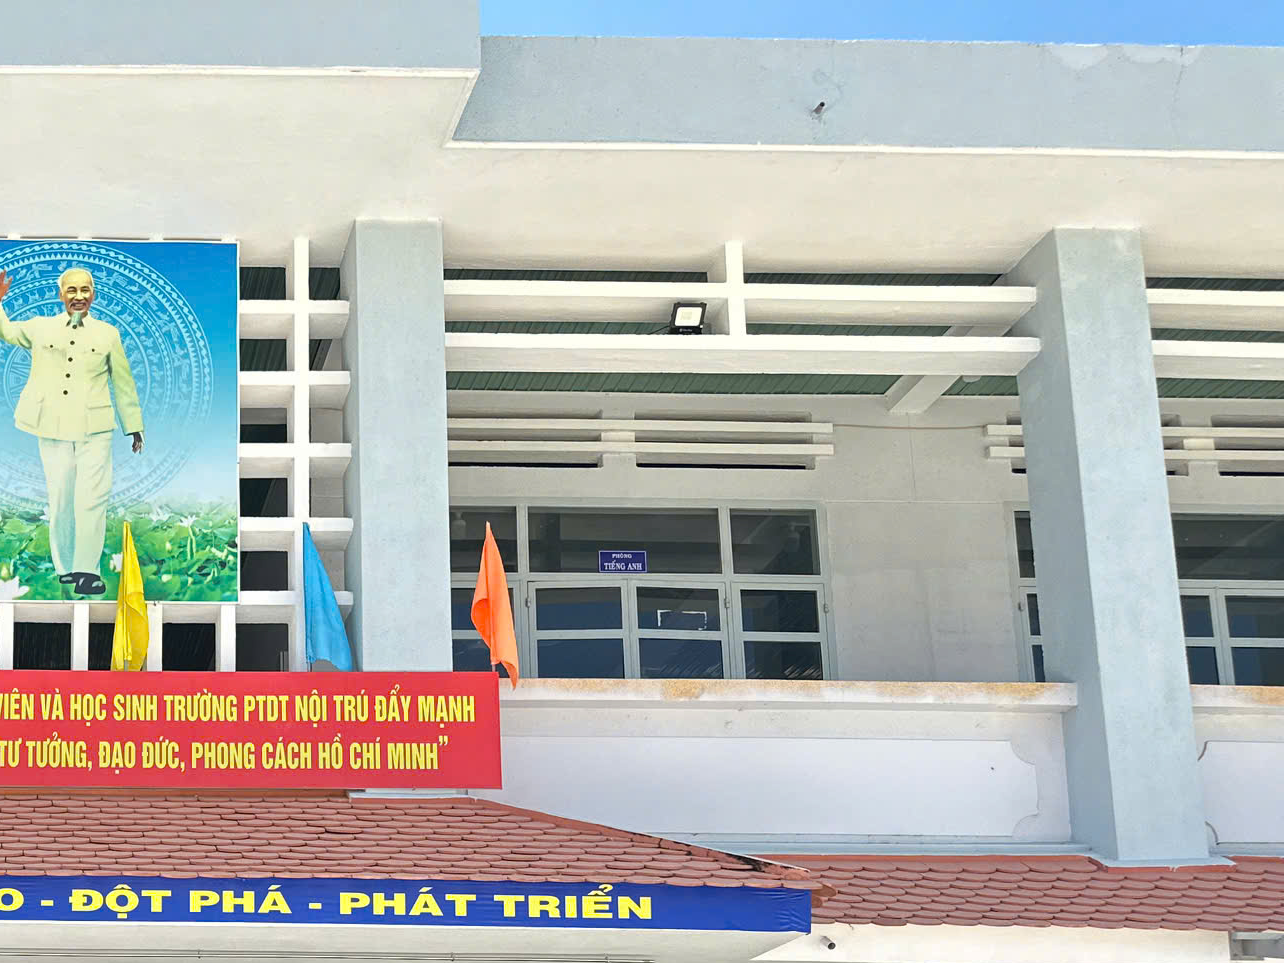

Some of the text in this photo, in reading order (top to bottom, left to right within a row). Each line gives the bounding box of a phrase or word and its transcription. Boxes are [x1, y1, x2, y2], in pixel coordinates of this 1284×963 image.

[603, 560, 643, 571] TIẾNG ANH
[40, 689, 64, 721] VÀ
[70, 694, 107, 727] HỌC
[113, 694, 157, 721] SINH
[164, 688, 237, 722] TRƯỜNG
[243, 695, 289, 722] PTDT
[295, 689, 327, 728] NỘI
[333, 689, 369, 722] TRÚ
[375, 683, 411, 722] ĐẨY
[418, 695, 475, 728] MẠNH
[25, 731, 93, 772] TƯỞNG,
[98, 740, 136, 774] ĐẠO
[141, 737, 185, 772] ĐỨC,
[191, 742, 255, 769] PHONG
[261, 737, 312, 770] CÁCH
[318, 733, 344, 770] HỒ
[349, 736, 381, 770] CHÍ
[387, 735, 449, 770] MINH”
[69, 884, 172, 919] ĐỘT
[189, 884, 292, 914] PHÁ
[339, 886, 477, 917] PHÁT
[494, 883, 652, 919] TRIỂN
